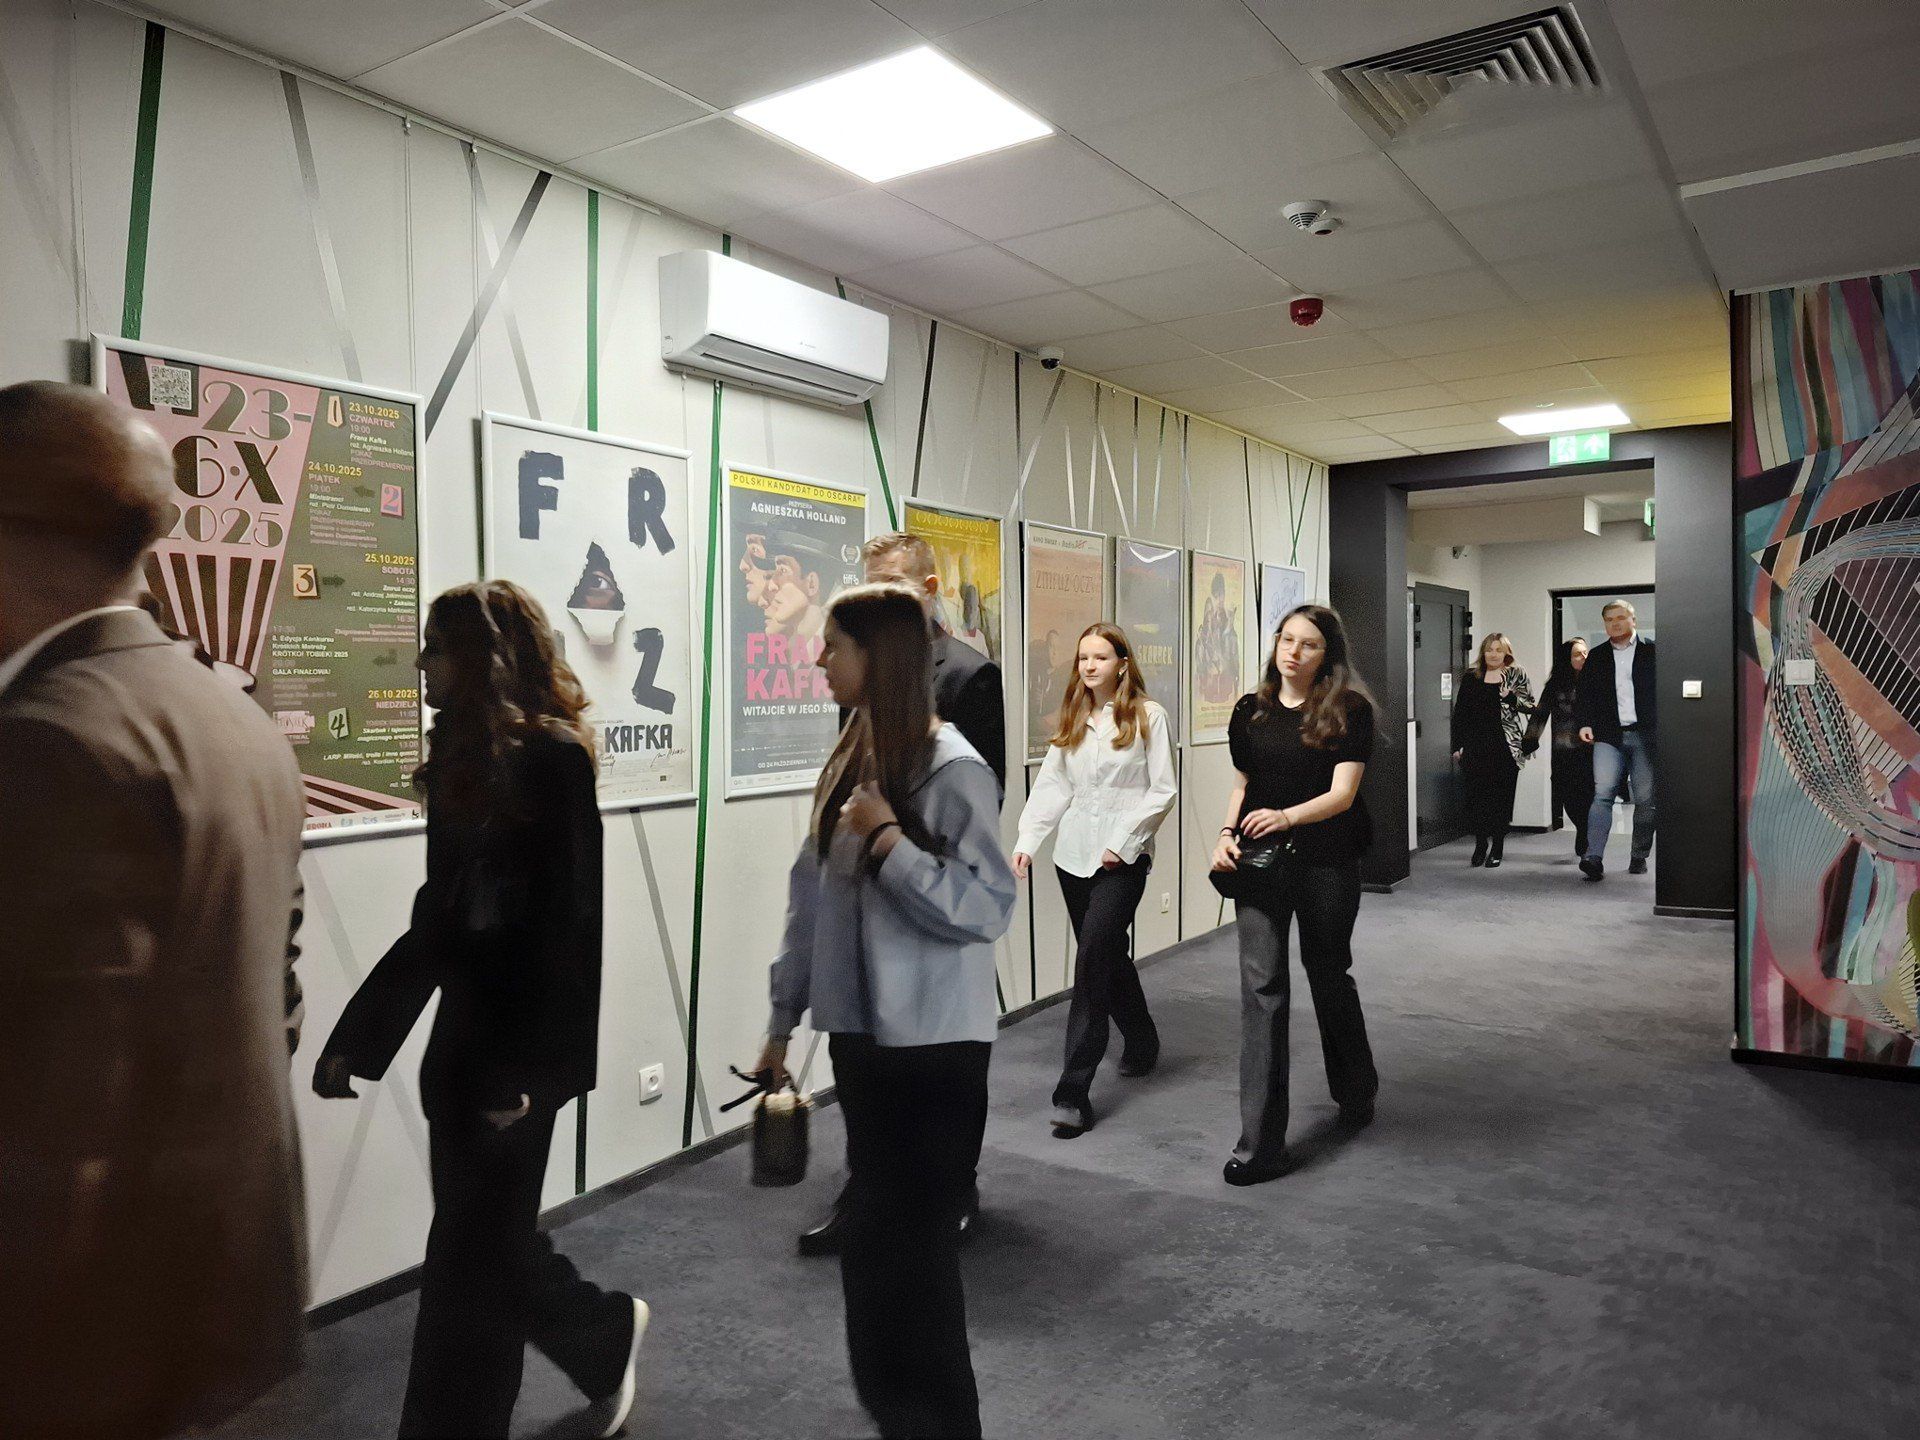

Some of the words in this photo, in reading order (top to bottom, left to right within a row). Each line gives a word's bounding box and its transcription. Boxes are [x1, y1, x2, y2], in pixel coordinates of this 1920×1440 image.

[348, 401, 400, 420] 23.10.2025
[349, 413, 396, 429] CZWARTEK
[308, 460, 362, 477] 24.10.2025
[733, 474, 765, 486] POLSKI
[767, 479, 812, 495] KANDYDAT
[813, 488, 826, 497] DO
[383, 486, 400, 514] 2
[519, 450, 564, 540] F
[628, 467, 676, 556] R
[751, 502, 805, 519] AGNIESZKA
[806, 510, 847, 525] HOLLAND
[364, 553, 415, 566] 25.10.2025
[381, 565, 415, 576] SOBOTA
[296, 567, 315, 593] 3
[632, 627, 676, 714] Z
[376, 701, 418, 709] NIEDZIELA
[743, 705, 786, 717] WITAJCIE
[787, 704, 798, 714] W
[799, 704, 821, 714] JEGO
[330, 713, 345, 739] 4
[605, 723, 673, 753] KAFKA
